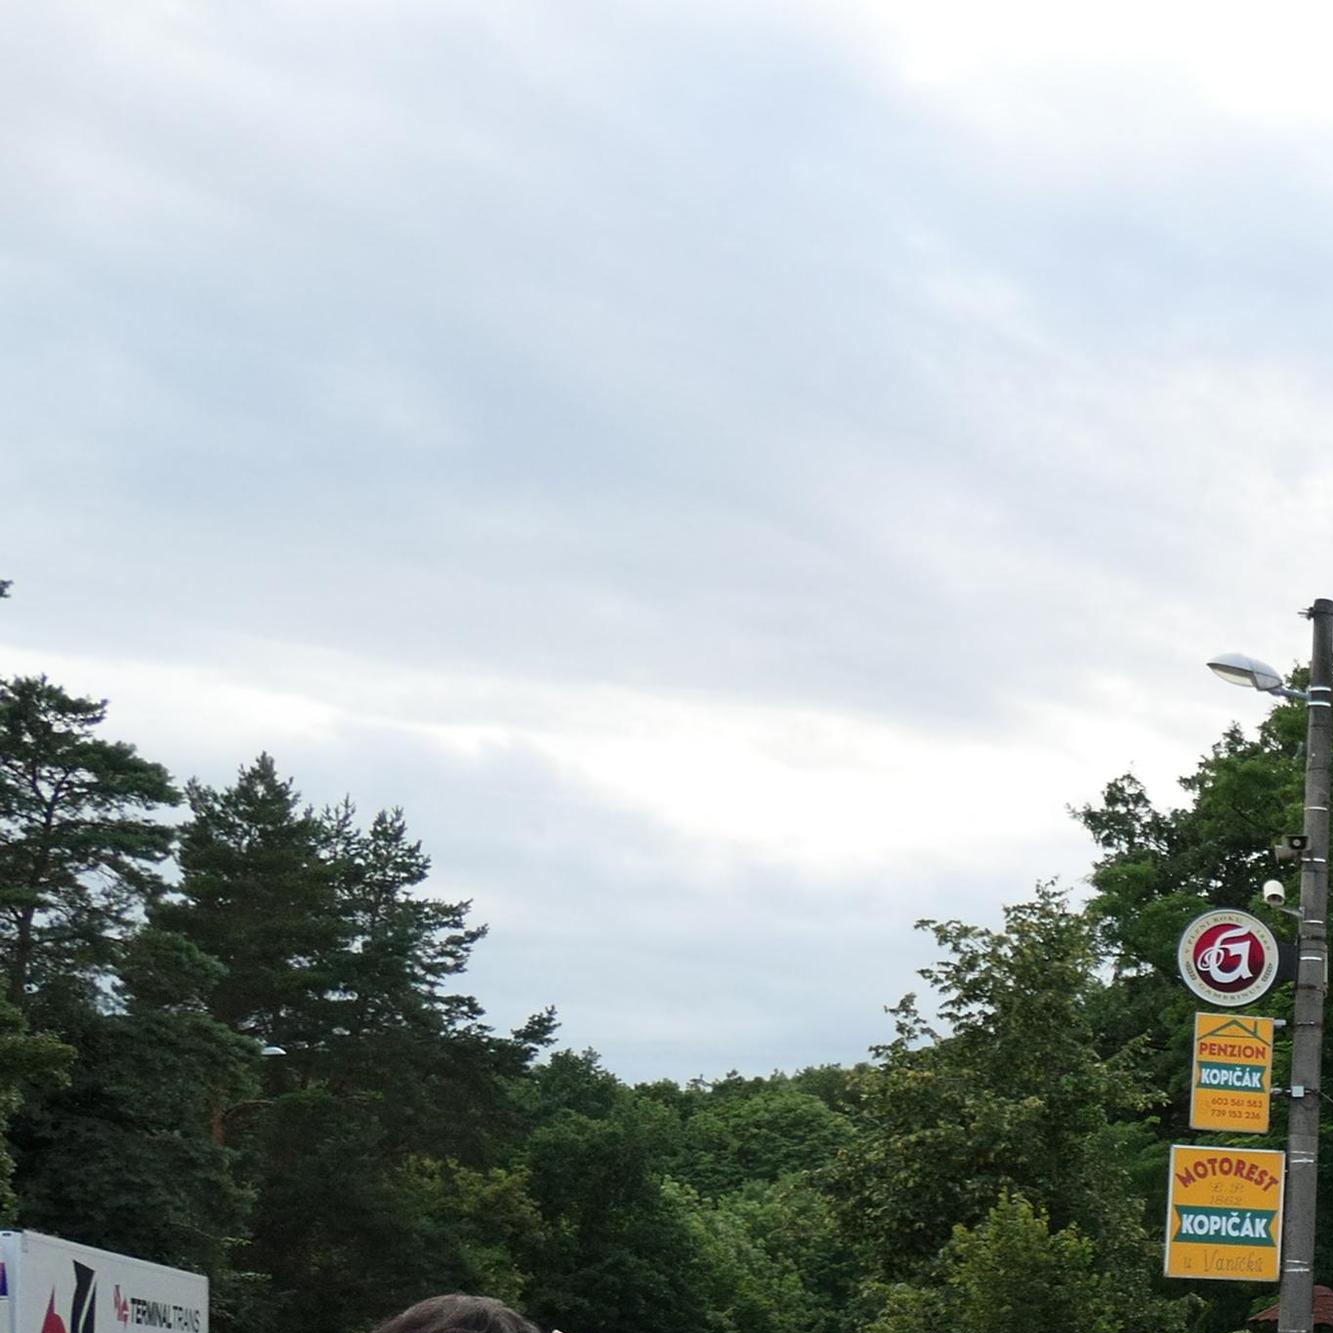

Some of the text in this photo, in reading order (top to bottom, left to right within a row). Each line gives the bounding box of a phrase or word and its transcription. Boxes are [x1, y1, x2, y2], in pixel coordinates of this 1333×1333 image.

[1199, 1042, 1267, 1060] PENZION
[1201, 1066, 1263, 1089] KOPIČÁK
[1175, 1156, 1280, 1193] MOTOREST
[1181, 1208, 1268, 1239] KOPIČÁK
